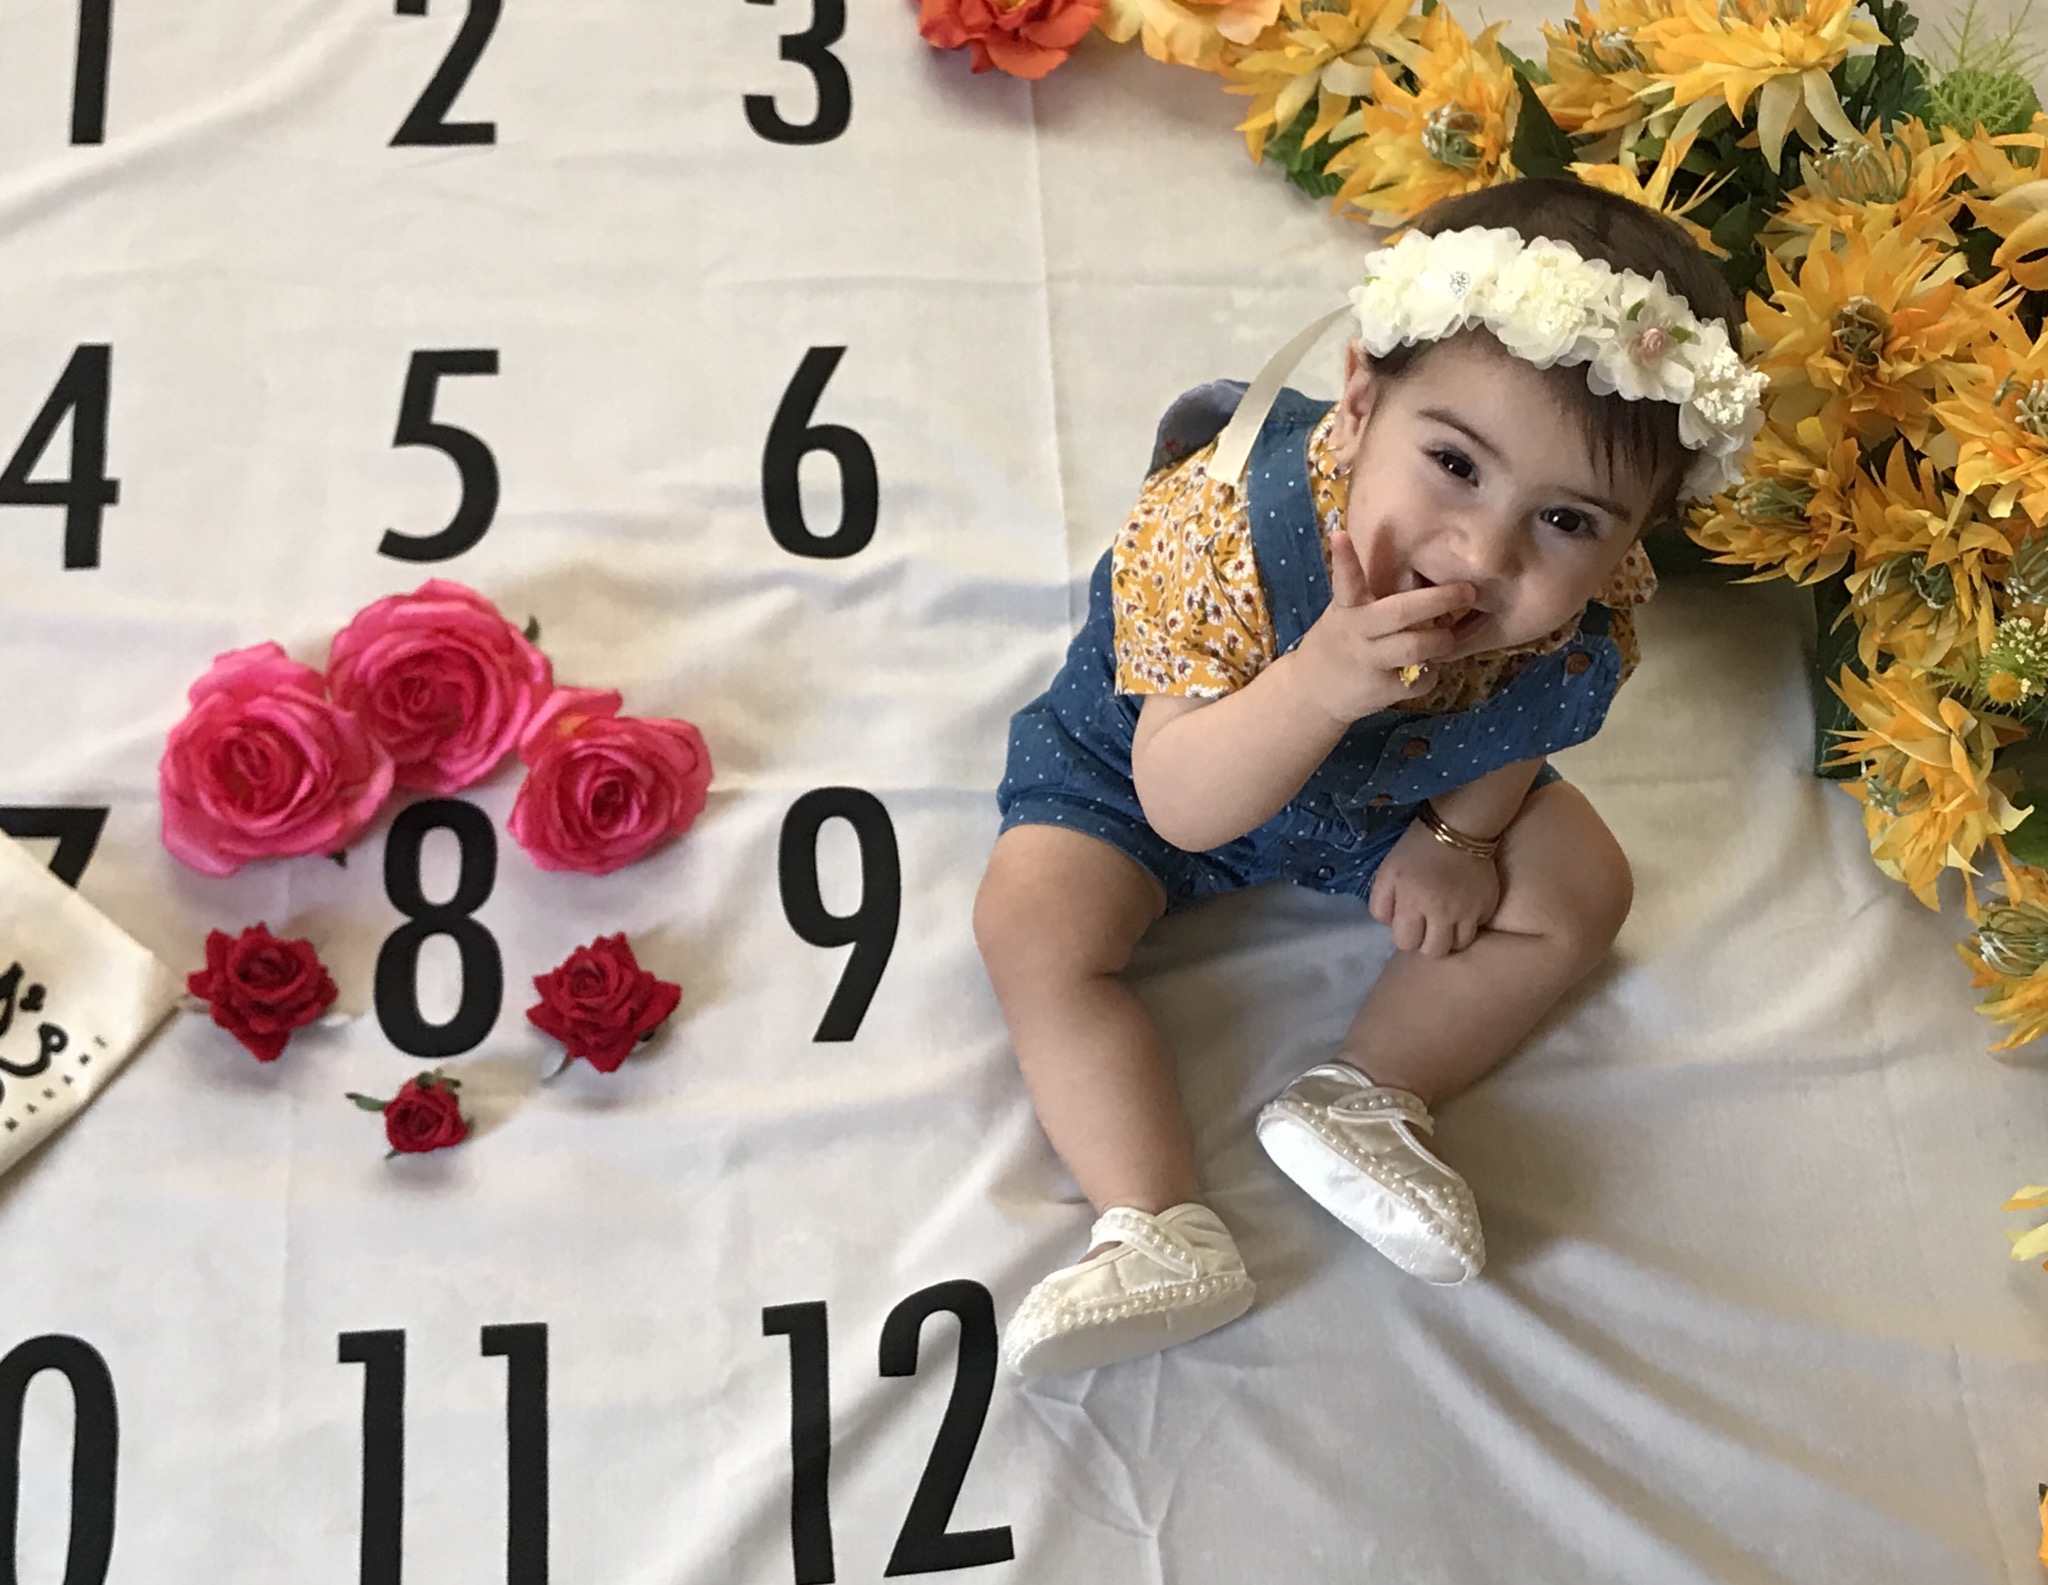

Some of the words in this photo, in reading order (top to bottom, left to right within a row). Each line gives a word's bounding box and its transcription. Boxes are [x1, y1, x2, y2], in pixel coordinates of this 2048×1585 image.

[391, 0, 501, 146] 2
[745, 0, 852, 145] 3
[0, 346, 118, 569] 4
[379, 349, 499, 562] 5
[762, 346, 879, 559] 6
[375, 797, 502, 1059] 8
[779, 787, 902, 1043] 9
[338, 1323, 549, 1585] 11
[762, 1279, 1015, 1585] 12
